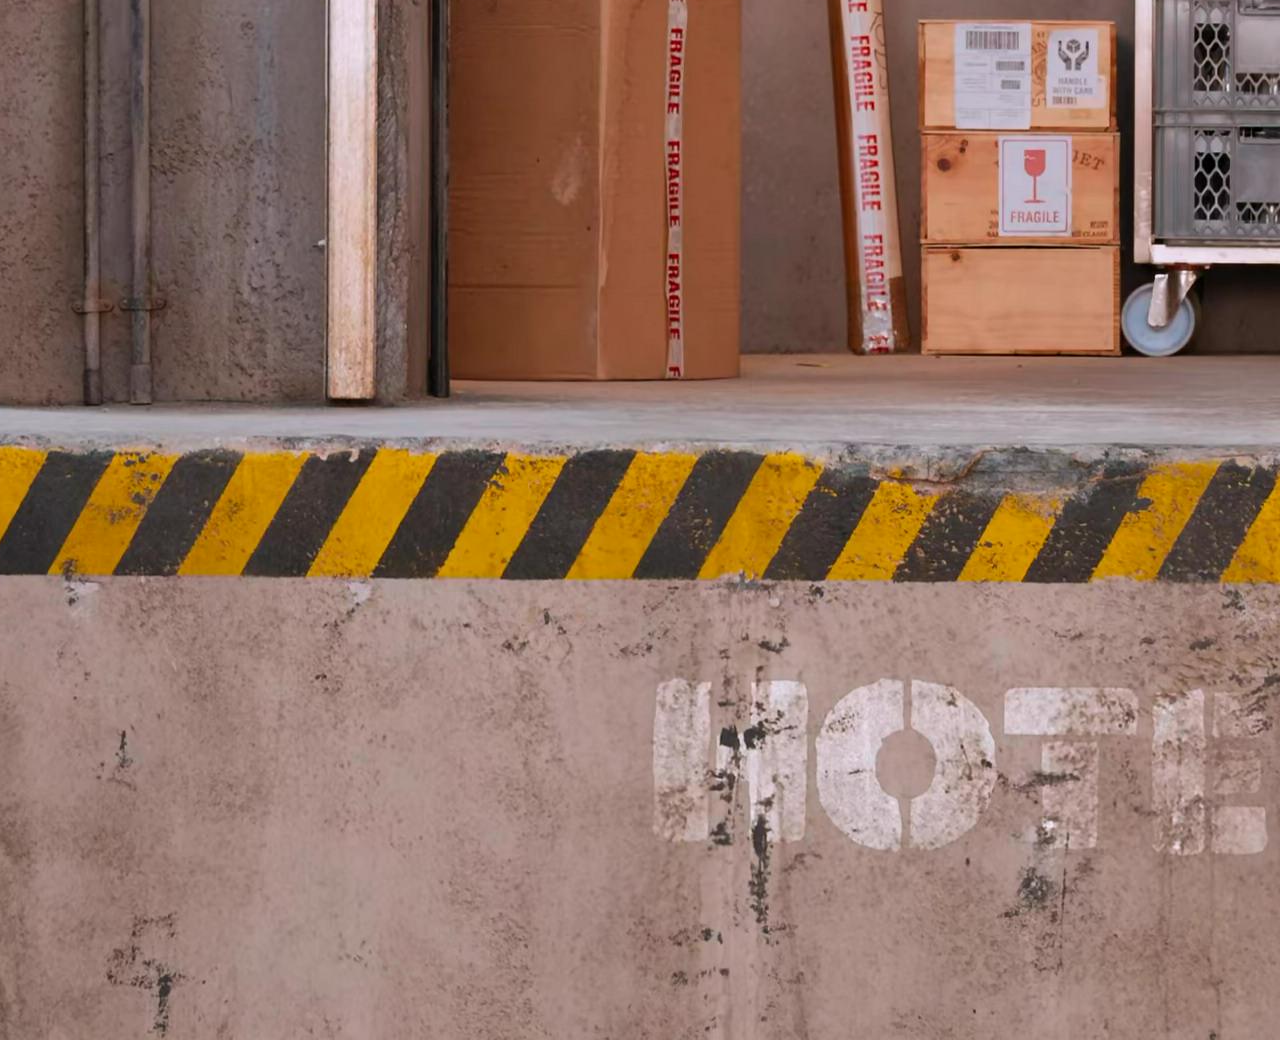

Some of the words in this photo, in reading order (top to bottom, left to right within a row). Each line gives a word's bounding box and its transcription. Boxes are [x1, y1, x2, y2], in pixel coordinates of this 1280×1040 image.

[667, 27, 683, 114] FRAGILE
[851, 34, 875, 112] FRAGILE
[1057, 77, 1088, 86] HANDLE
[667, 140, 681, 228] FRAGILE
[858, 134, 882, 212] FRAGILE
[1010, 210, 1060, 224] FRAGILE
[668, 253, 681, 340] FRAGILE
[864, 234, 888, 312] FRAGILE
